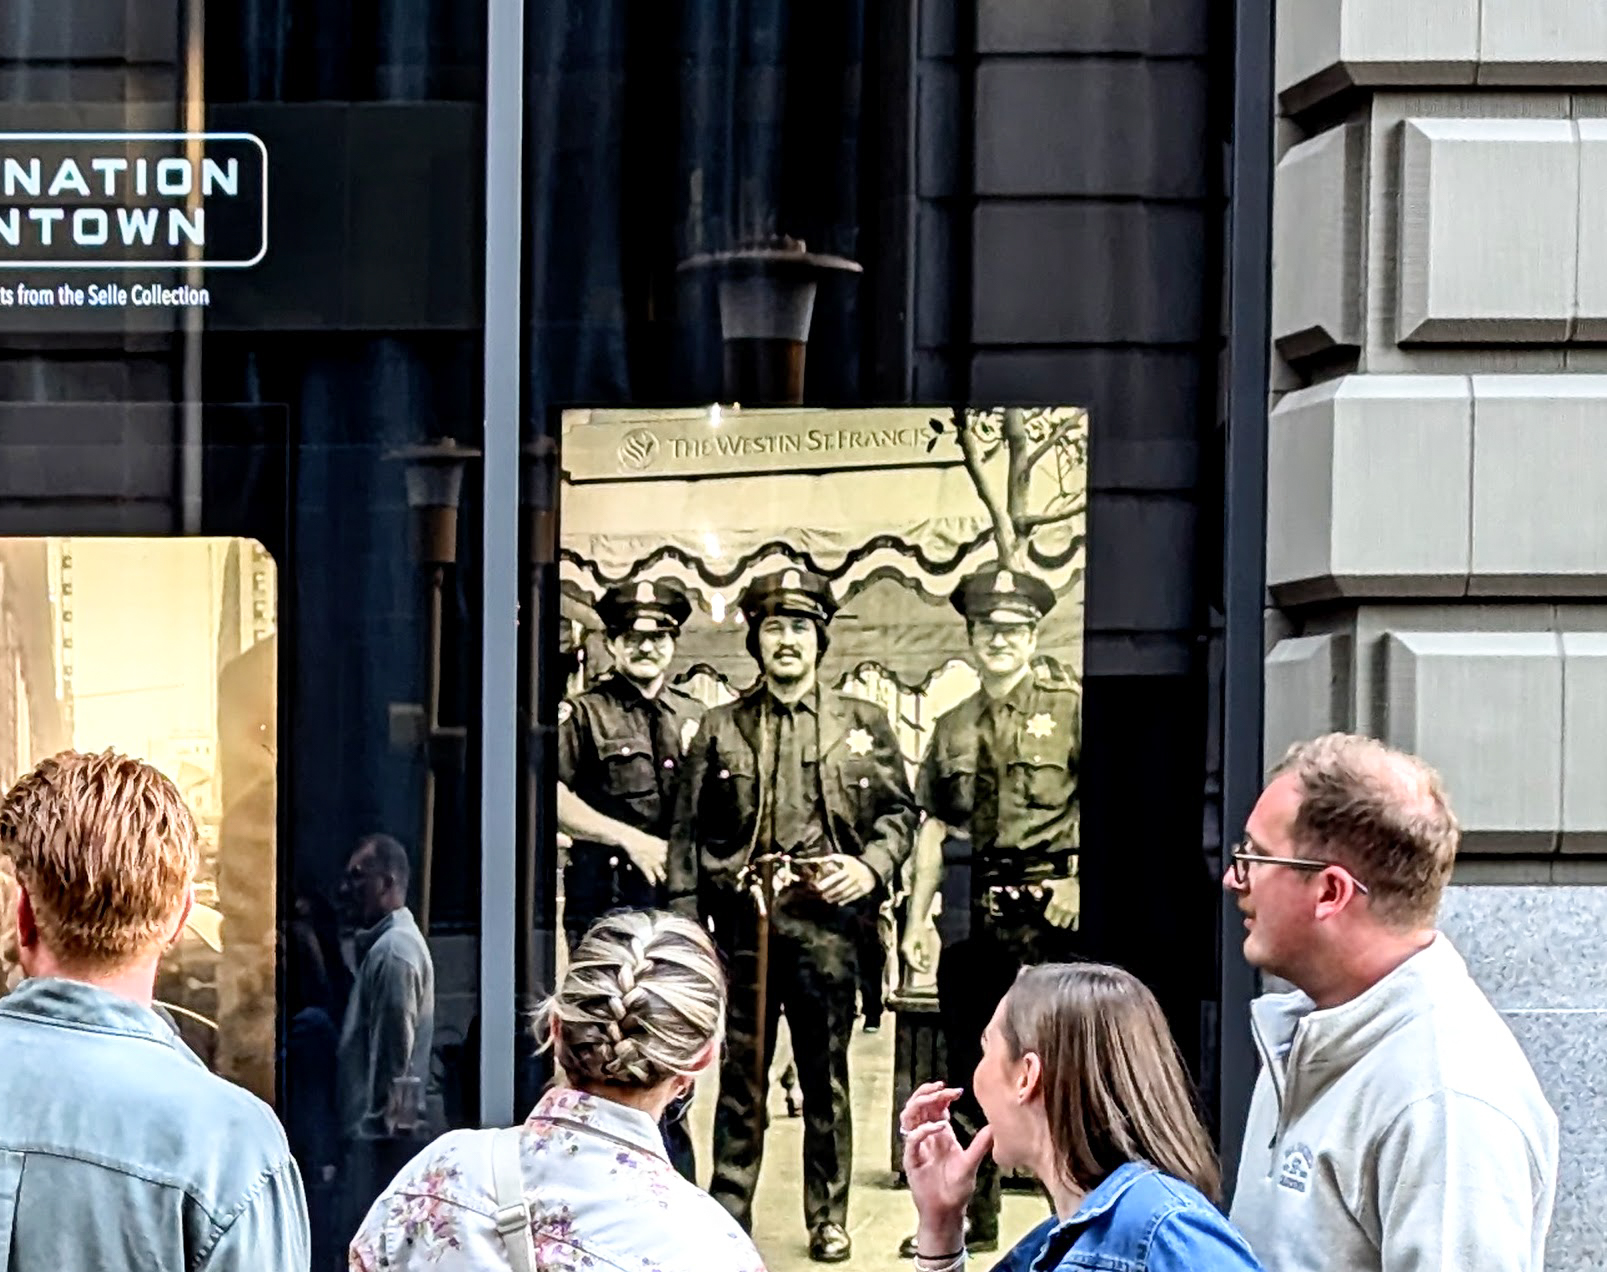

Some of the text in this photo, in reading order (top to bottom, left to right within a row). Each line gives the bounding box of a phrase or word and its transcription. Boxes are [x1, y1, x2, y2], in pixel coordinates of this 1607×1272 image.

[17, 282, 54, 306] from
[57, 283, 85, 306] the
[88, 284, 128, 306] Selle
[131, 284, 210, 306] Collection
[668, 438, 711, 459] THE
[714, 433, 801, 456] WESTIN
[836, 426, 932, 450] FRANCIS
